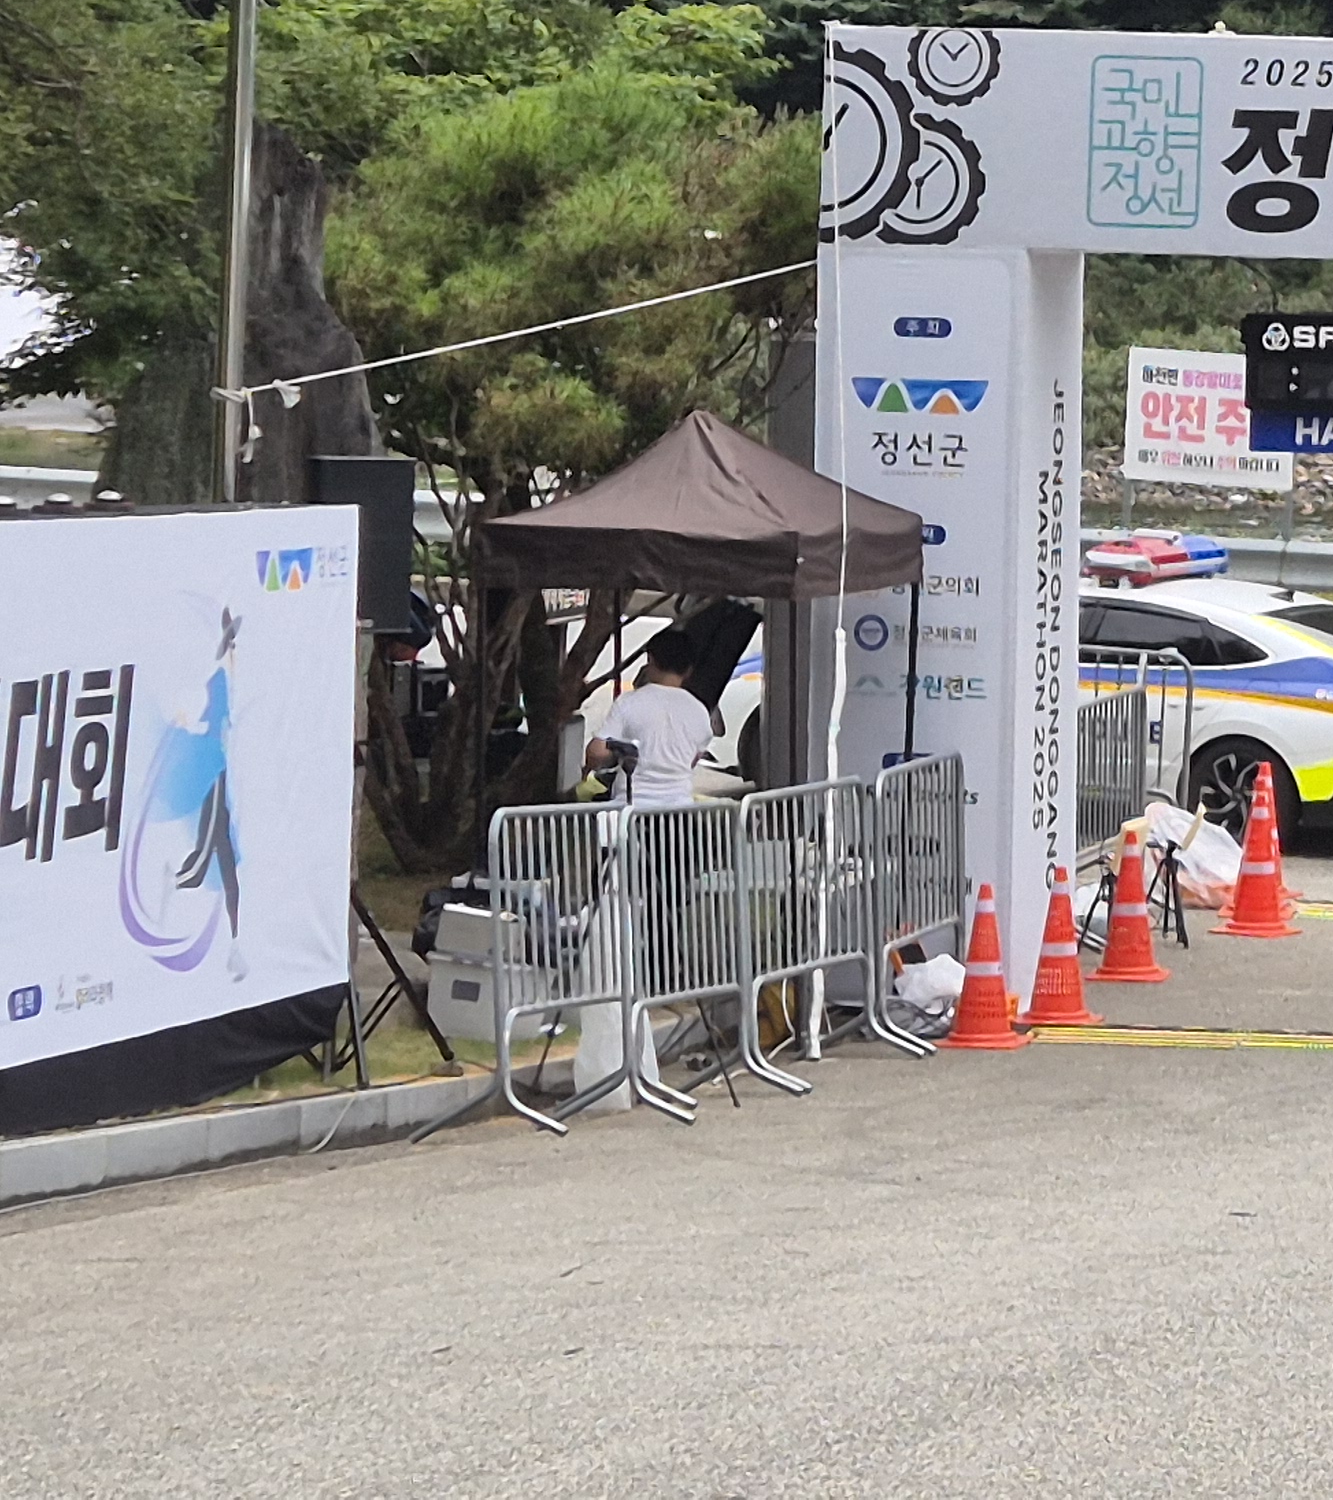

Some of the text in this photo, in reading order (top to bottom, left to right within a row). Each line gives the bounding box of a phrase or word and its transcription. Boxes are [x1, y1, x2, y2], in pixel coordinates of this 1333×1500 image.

[871, 431, 969, 469] 정선군
[1139, 390, 1251, 447] 안전 주
[1049, 378, 1065, 633] JEONGSEON
[893, 623, 978, 645] 정군체육회
[1032, 470, 1050, 831] MARATHON 2025
[0, 663, 135, 864] 대회
